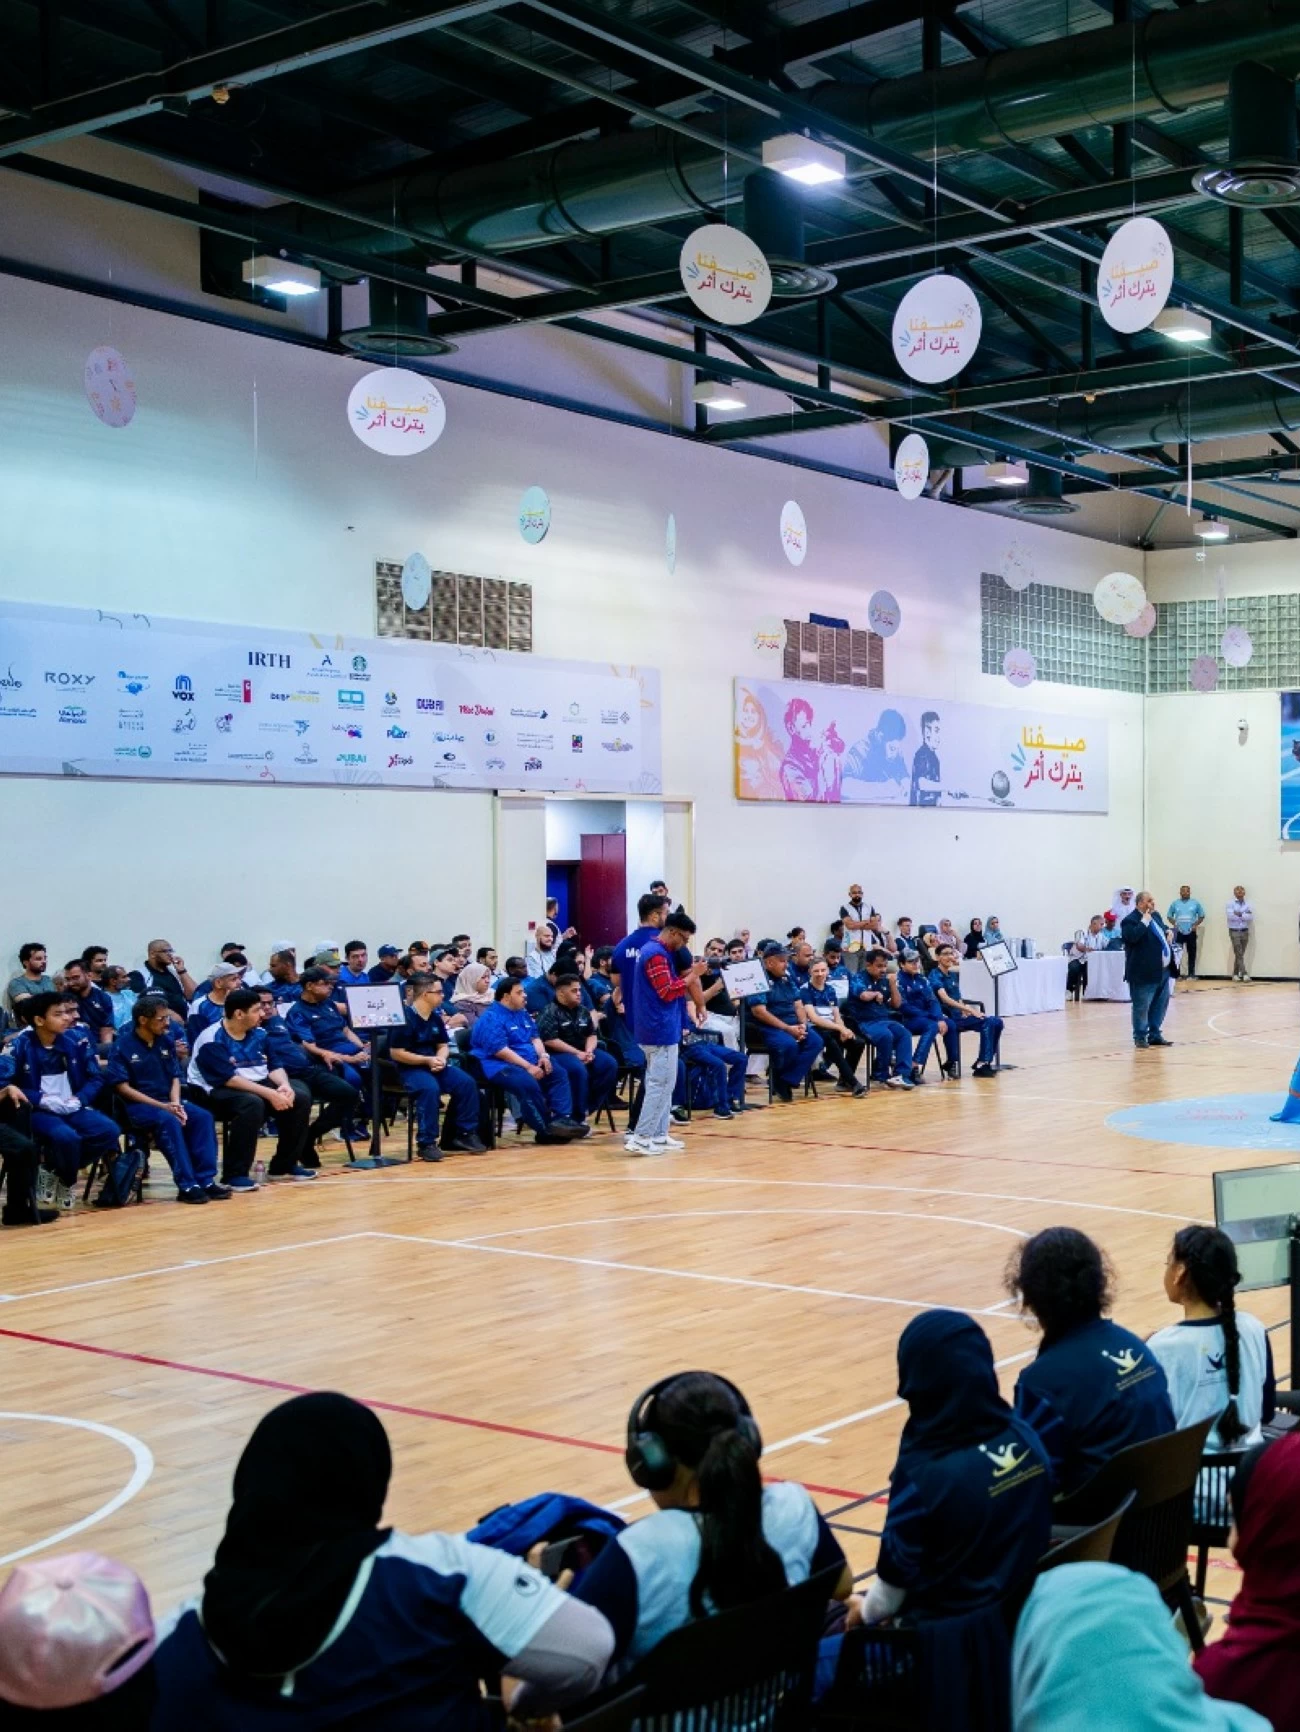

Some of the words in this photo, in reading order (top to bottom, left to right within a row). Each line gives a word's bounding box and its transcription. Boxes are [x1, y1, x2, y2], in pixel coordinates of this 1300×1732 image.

[696, 252, 757, 281] صيفنا
[1110, 258, 1159, 280] صيفنا
[697, 273, 716, 290] أثر
[1129, 279, 1156, 297] يترك
[722, 280, 753, 303] يترك
[1110, 279, 1127, 307] أثر
[908, 317, 964, 332] صيفنا
[908, 333, 926, 357] أثر
[930, 335, 960, 354] يترك
[366, 396, 428, 414] صيفنا
[368, 411, 386, 430] أثر
[392, 416, 425, 433] يترك
[248, 651, 291, 668] IRTH
[45, 672, 95, 685] ROXY
[172, 691, 195, 701] VOX
[1021, 725, 1086, 758] صيفنا
[1024, 751, 1045, 789] أثر
[1047, 760, 1084, 791] يترك
